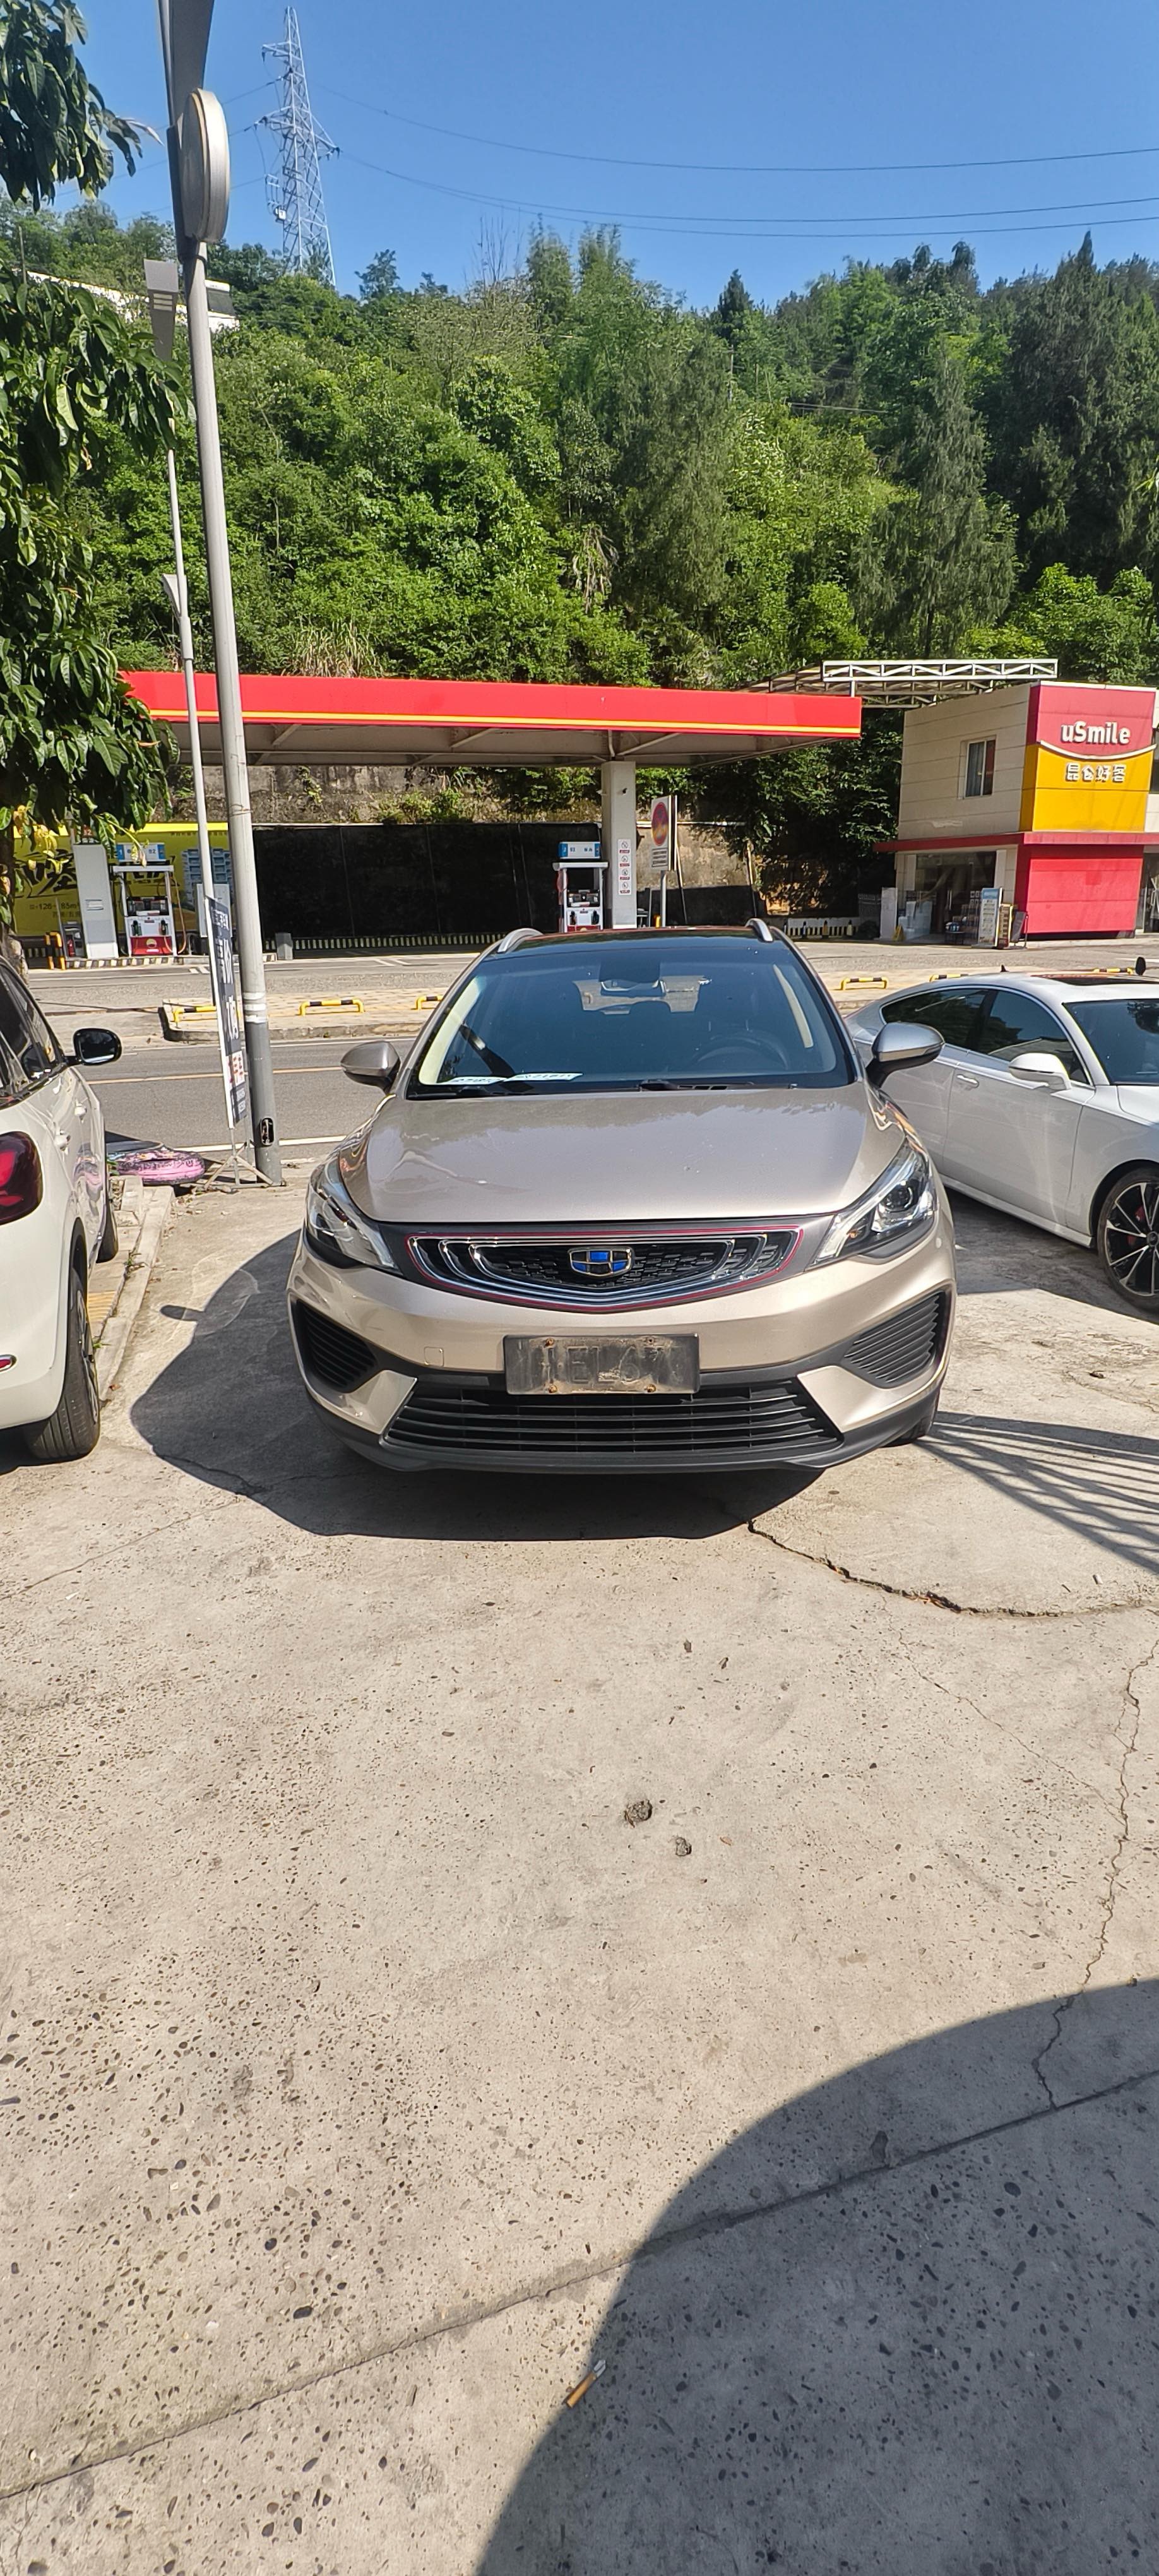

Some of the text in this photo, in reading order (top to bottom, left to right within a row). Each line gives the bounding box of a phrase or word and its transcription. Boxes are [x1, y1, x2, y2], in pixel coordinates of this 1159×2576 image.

[1061, 720, 1131, 744] uSmile
[1066, 763, 1127, 783] 昆仑好客
